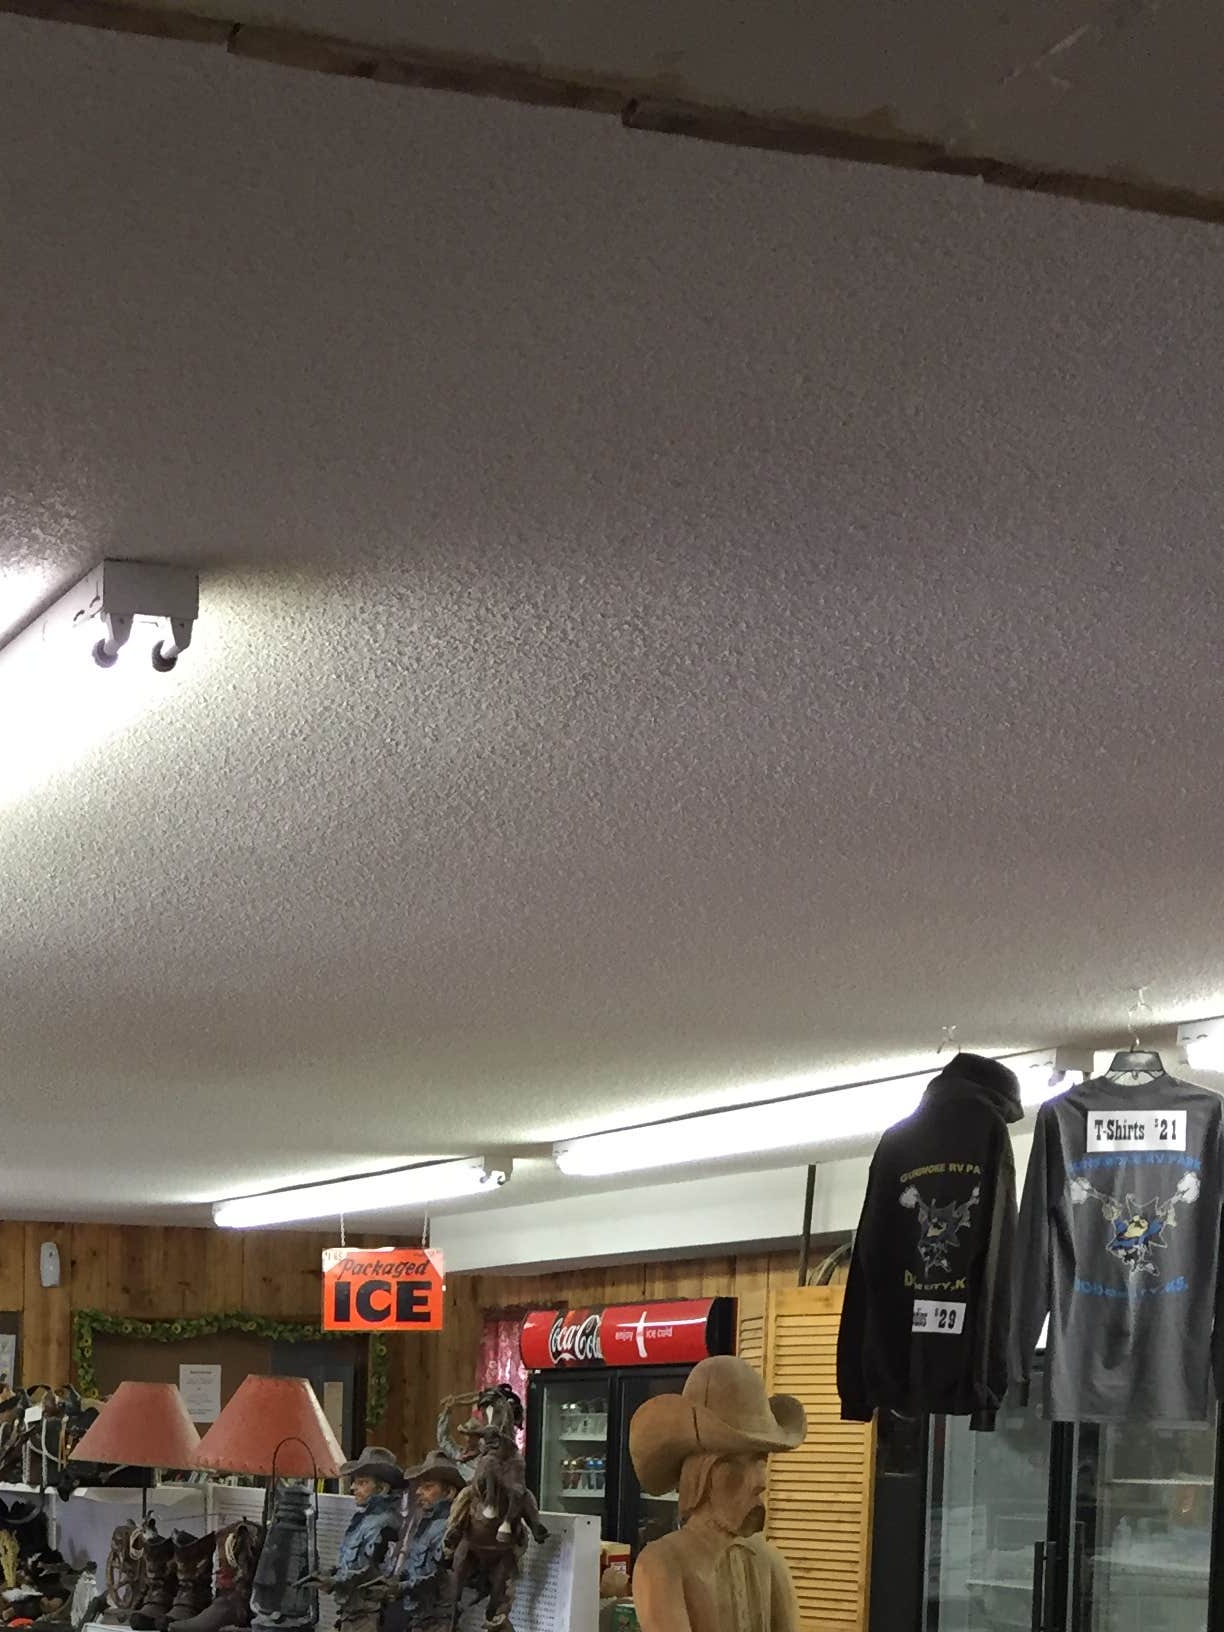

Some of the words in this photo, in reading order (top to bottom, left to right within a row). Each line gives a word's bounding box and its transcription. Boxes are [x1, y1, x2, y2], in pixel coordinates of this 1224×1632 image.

[1095, 1119, 1145, 1141] T-Shirts
[1154, 1118, 1177, 1141] $21
[966, 1163, 982, 1175] PA
[336, 1258, 432, 1281] Packaged
[334, 1279, 433, 1323] ICE
[935, 1308, 957, 1330] $29
[645, 1328, 656, 1339] ice
